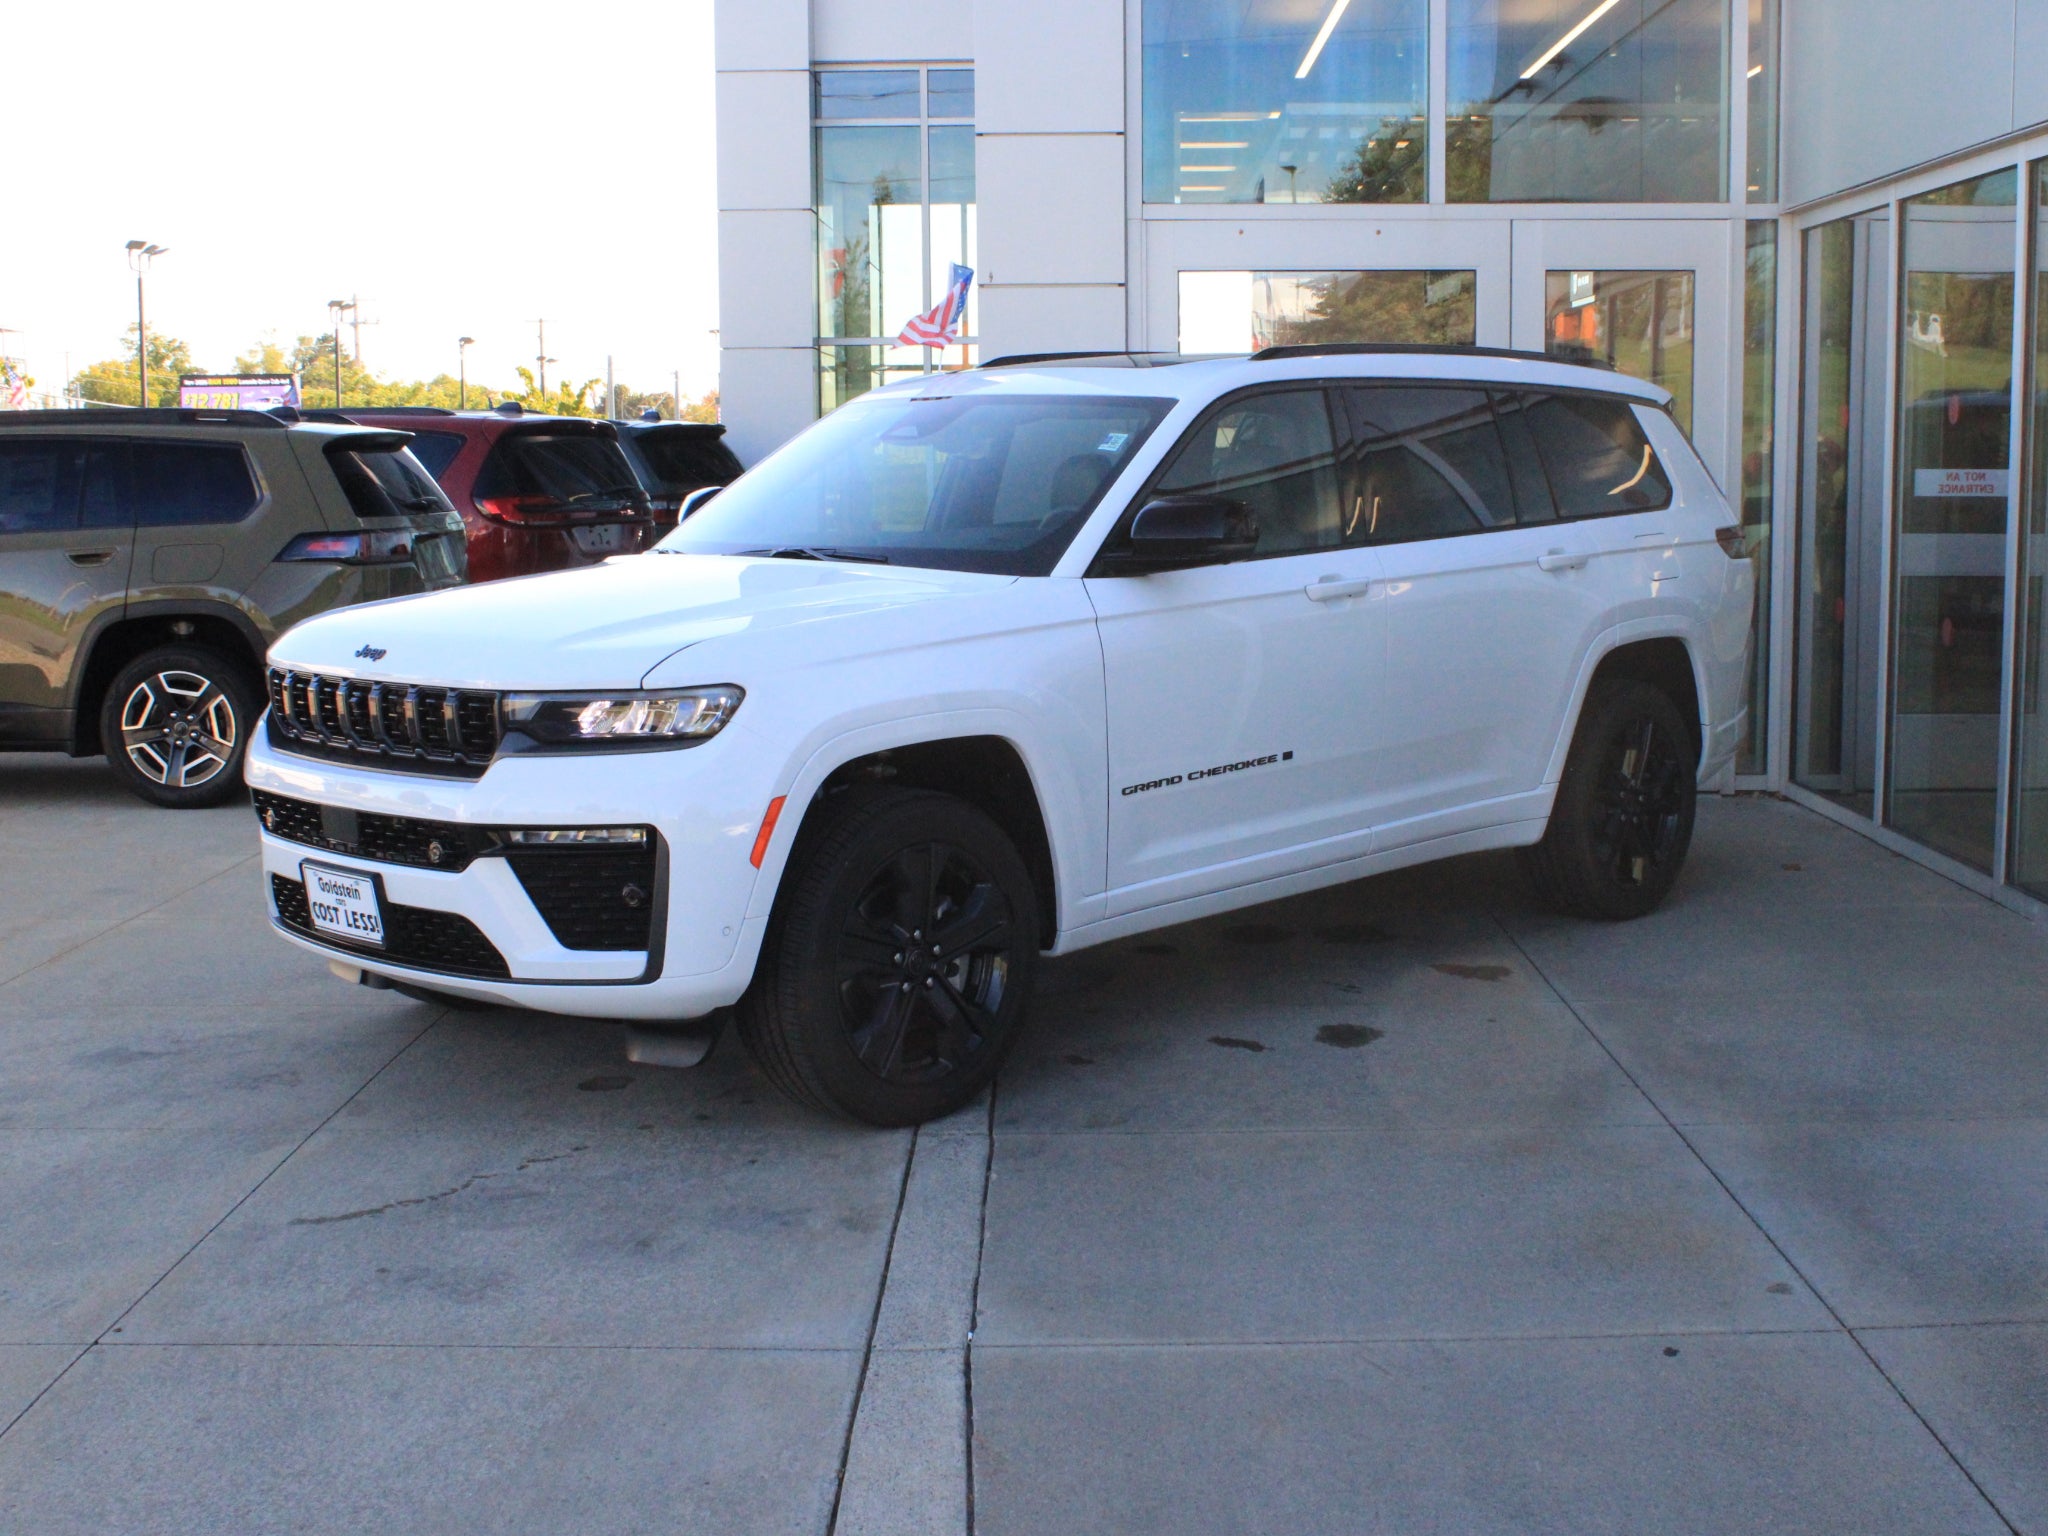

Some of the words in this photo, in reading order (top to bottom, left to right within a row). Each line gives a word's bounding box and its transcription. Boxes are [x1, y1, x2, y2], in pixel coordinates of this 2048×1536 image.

[355, 644, 387, 662] Jeep
[1121, 775, 1183, 796] GRAND
[1187, 754, 1278, 781] CHEROKEE
[318, 877, 361, 900] Goldstein
[313, 901, 340, 925] COST
[344, 909, 380, 934] LESS!
